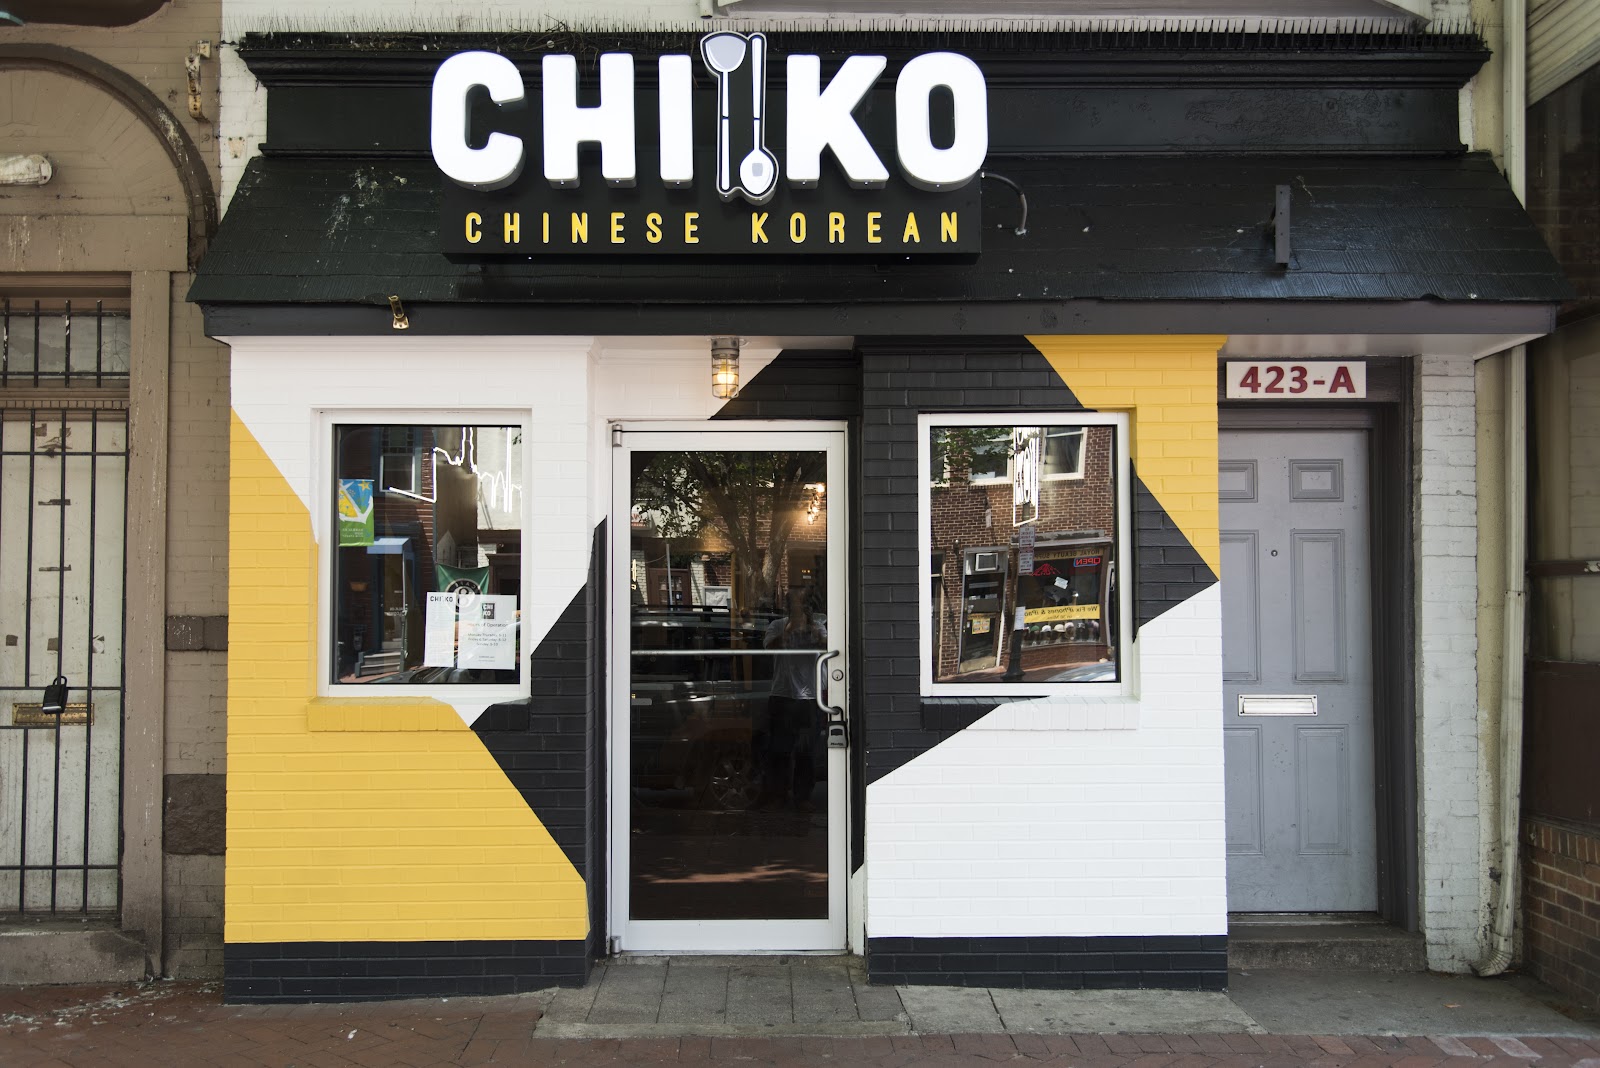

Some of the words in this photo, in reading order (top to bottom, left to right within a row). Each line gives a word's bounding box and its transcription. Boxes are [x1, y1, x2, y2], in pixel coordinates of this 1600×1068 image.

[464, 211, 701, 244] CHINESE
[750, 211, 960, 244] KOREAN
[1239, 365, 1357, 395] 423-A
